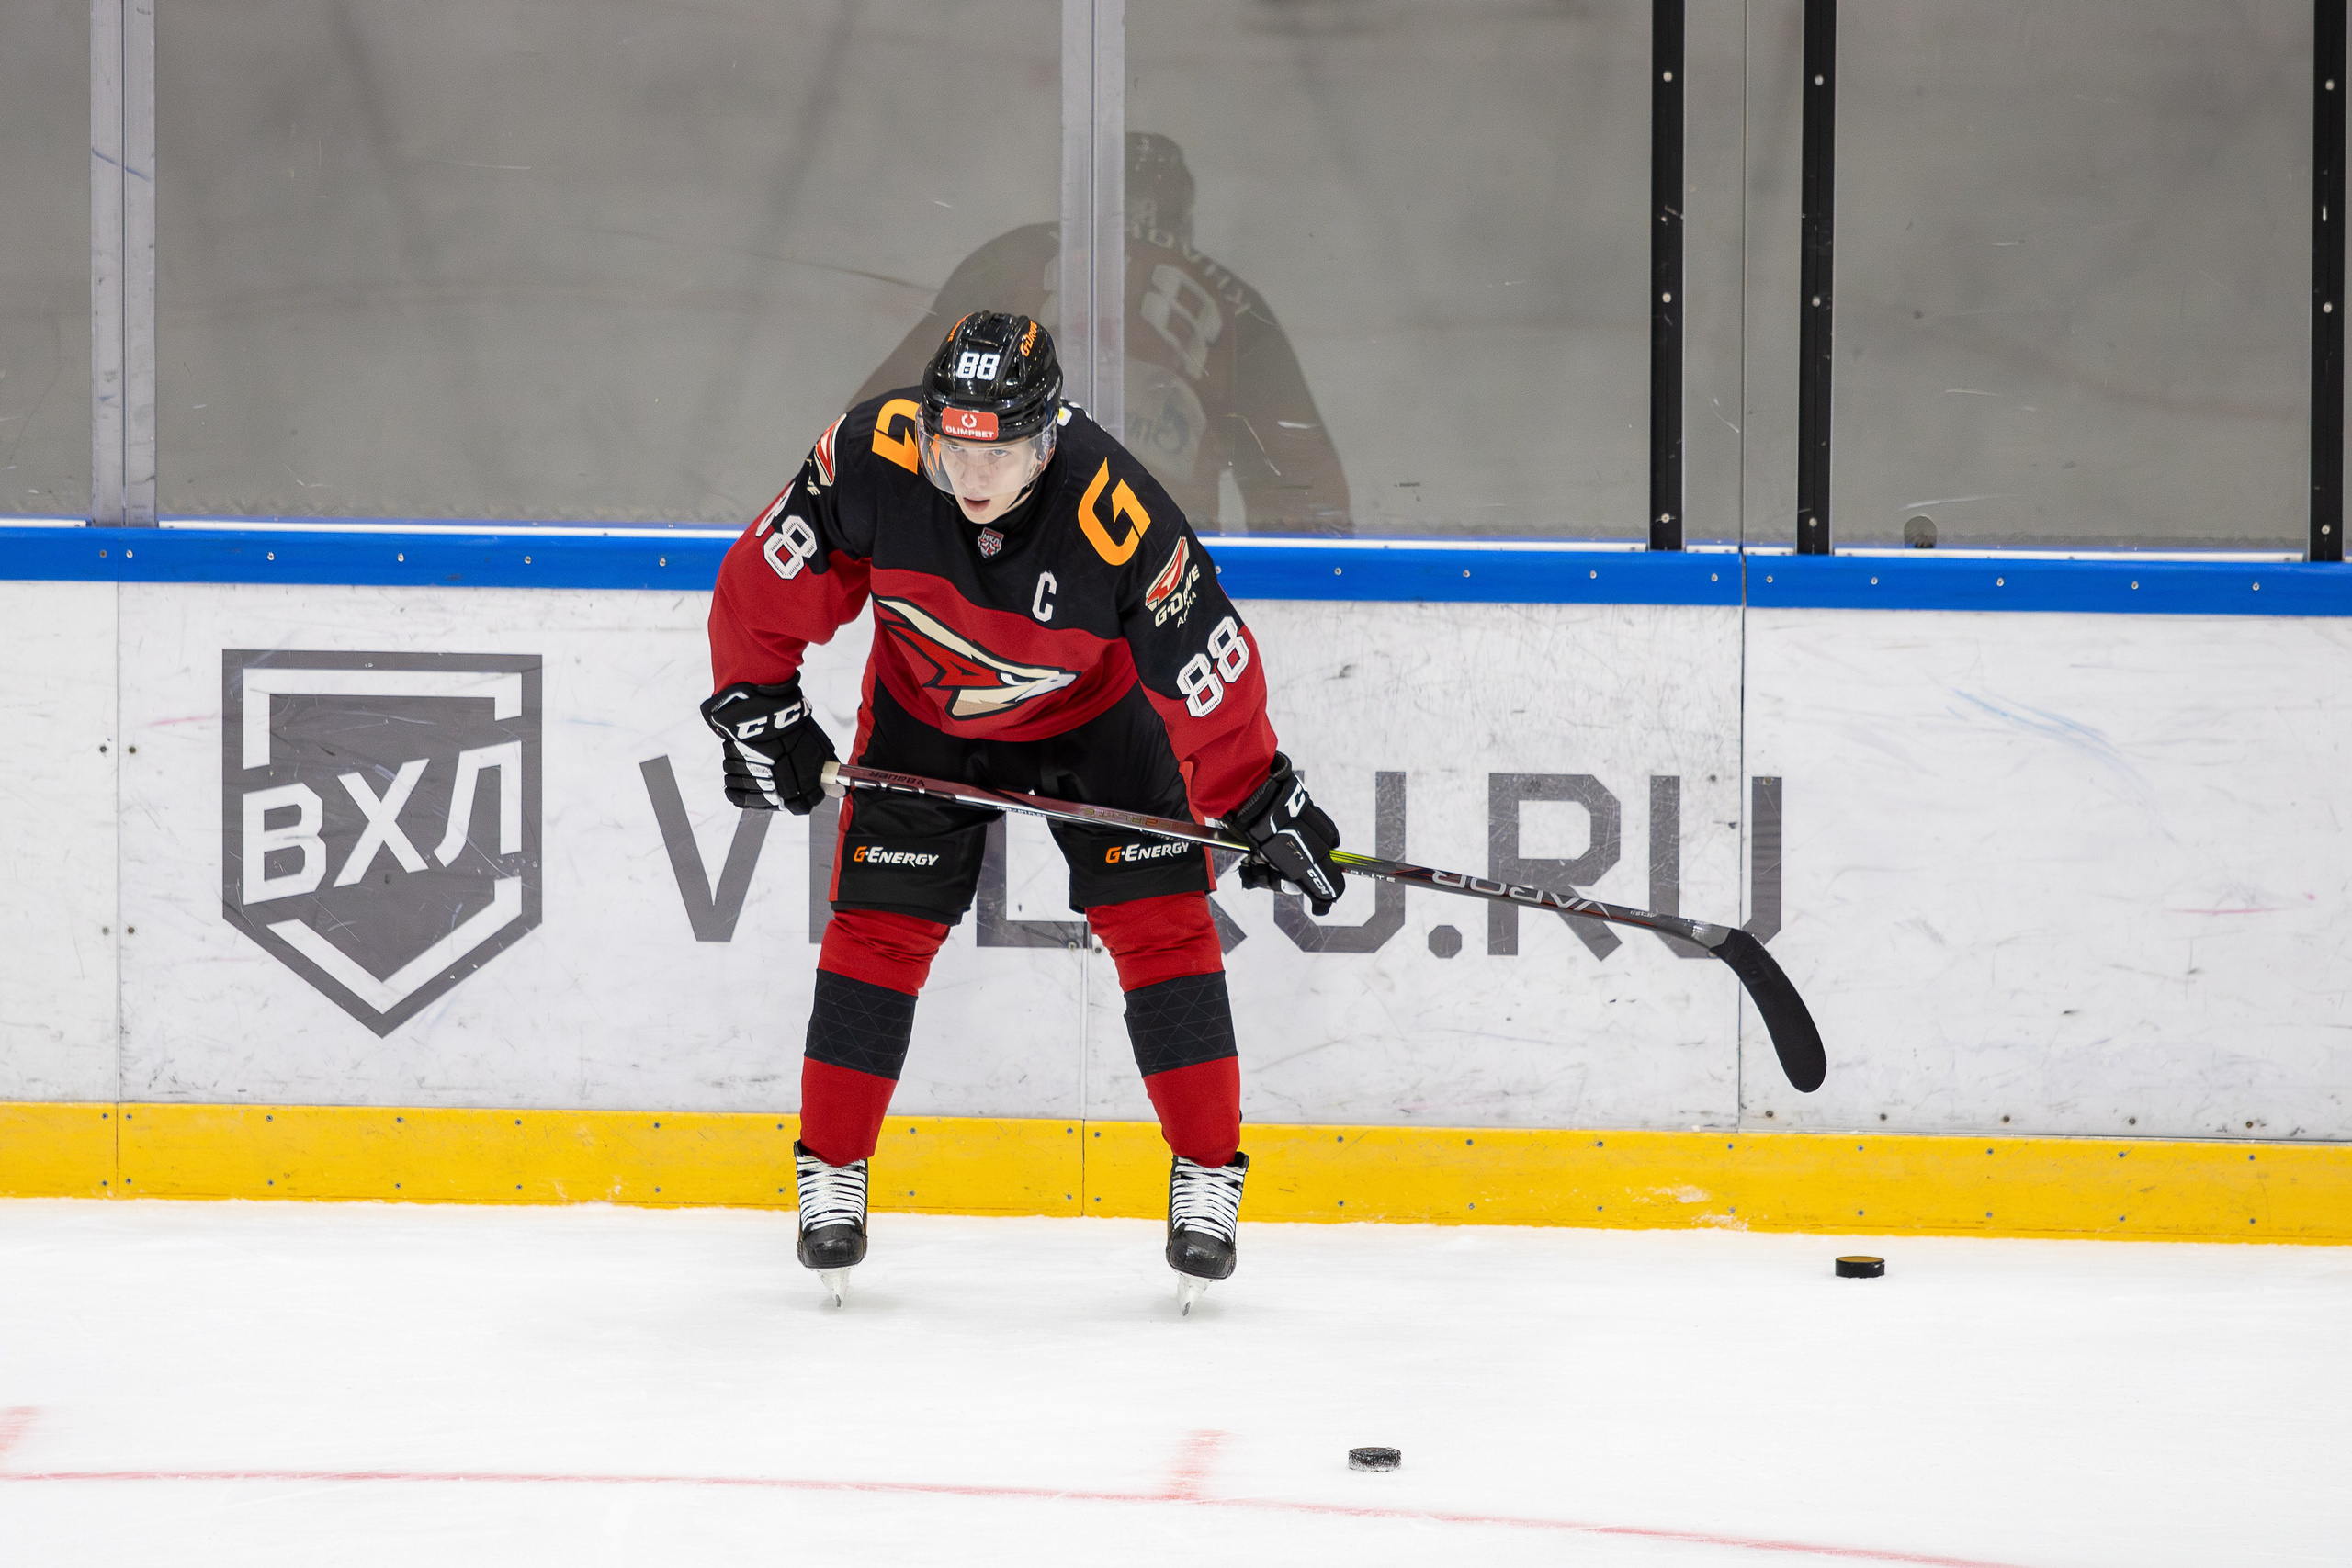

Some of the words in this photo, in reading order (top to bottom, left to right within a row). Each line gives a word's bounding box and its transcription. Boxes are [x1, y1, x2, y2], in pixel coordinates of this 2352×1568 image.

[956, 351, 1001, 380] 88
[945, 424, 995, 439] OLIMPBET
[1032, 570, 1057, 622] C
[1176, 616, 1250, 717] 88
[243, 740, 522, 906] ВХЛ
[854, 845, 939, 867] G-ENERGY
[1105, 841, 1189, 863] G-ENERGY
[1306, 868, 1329, 895] CCM
[1431, 869, 1612, 921] VAPOR
